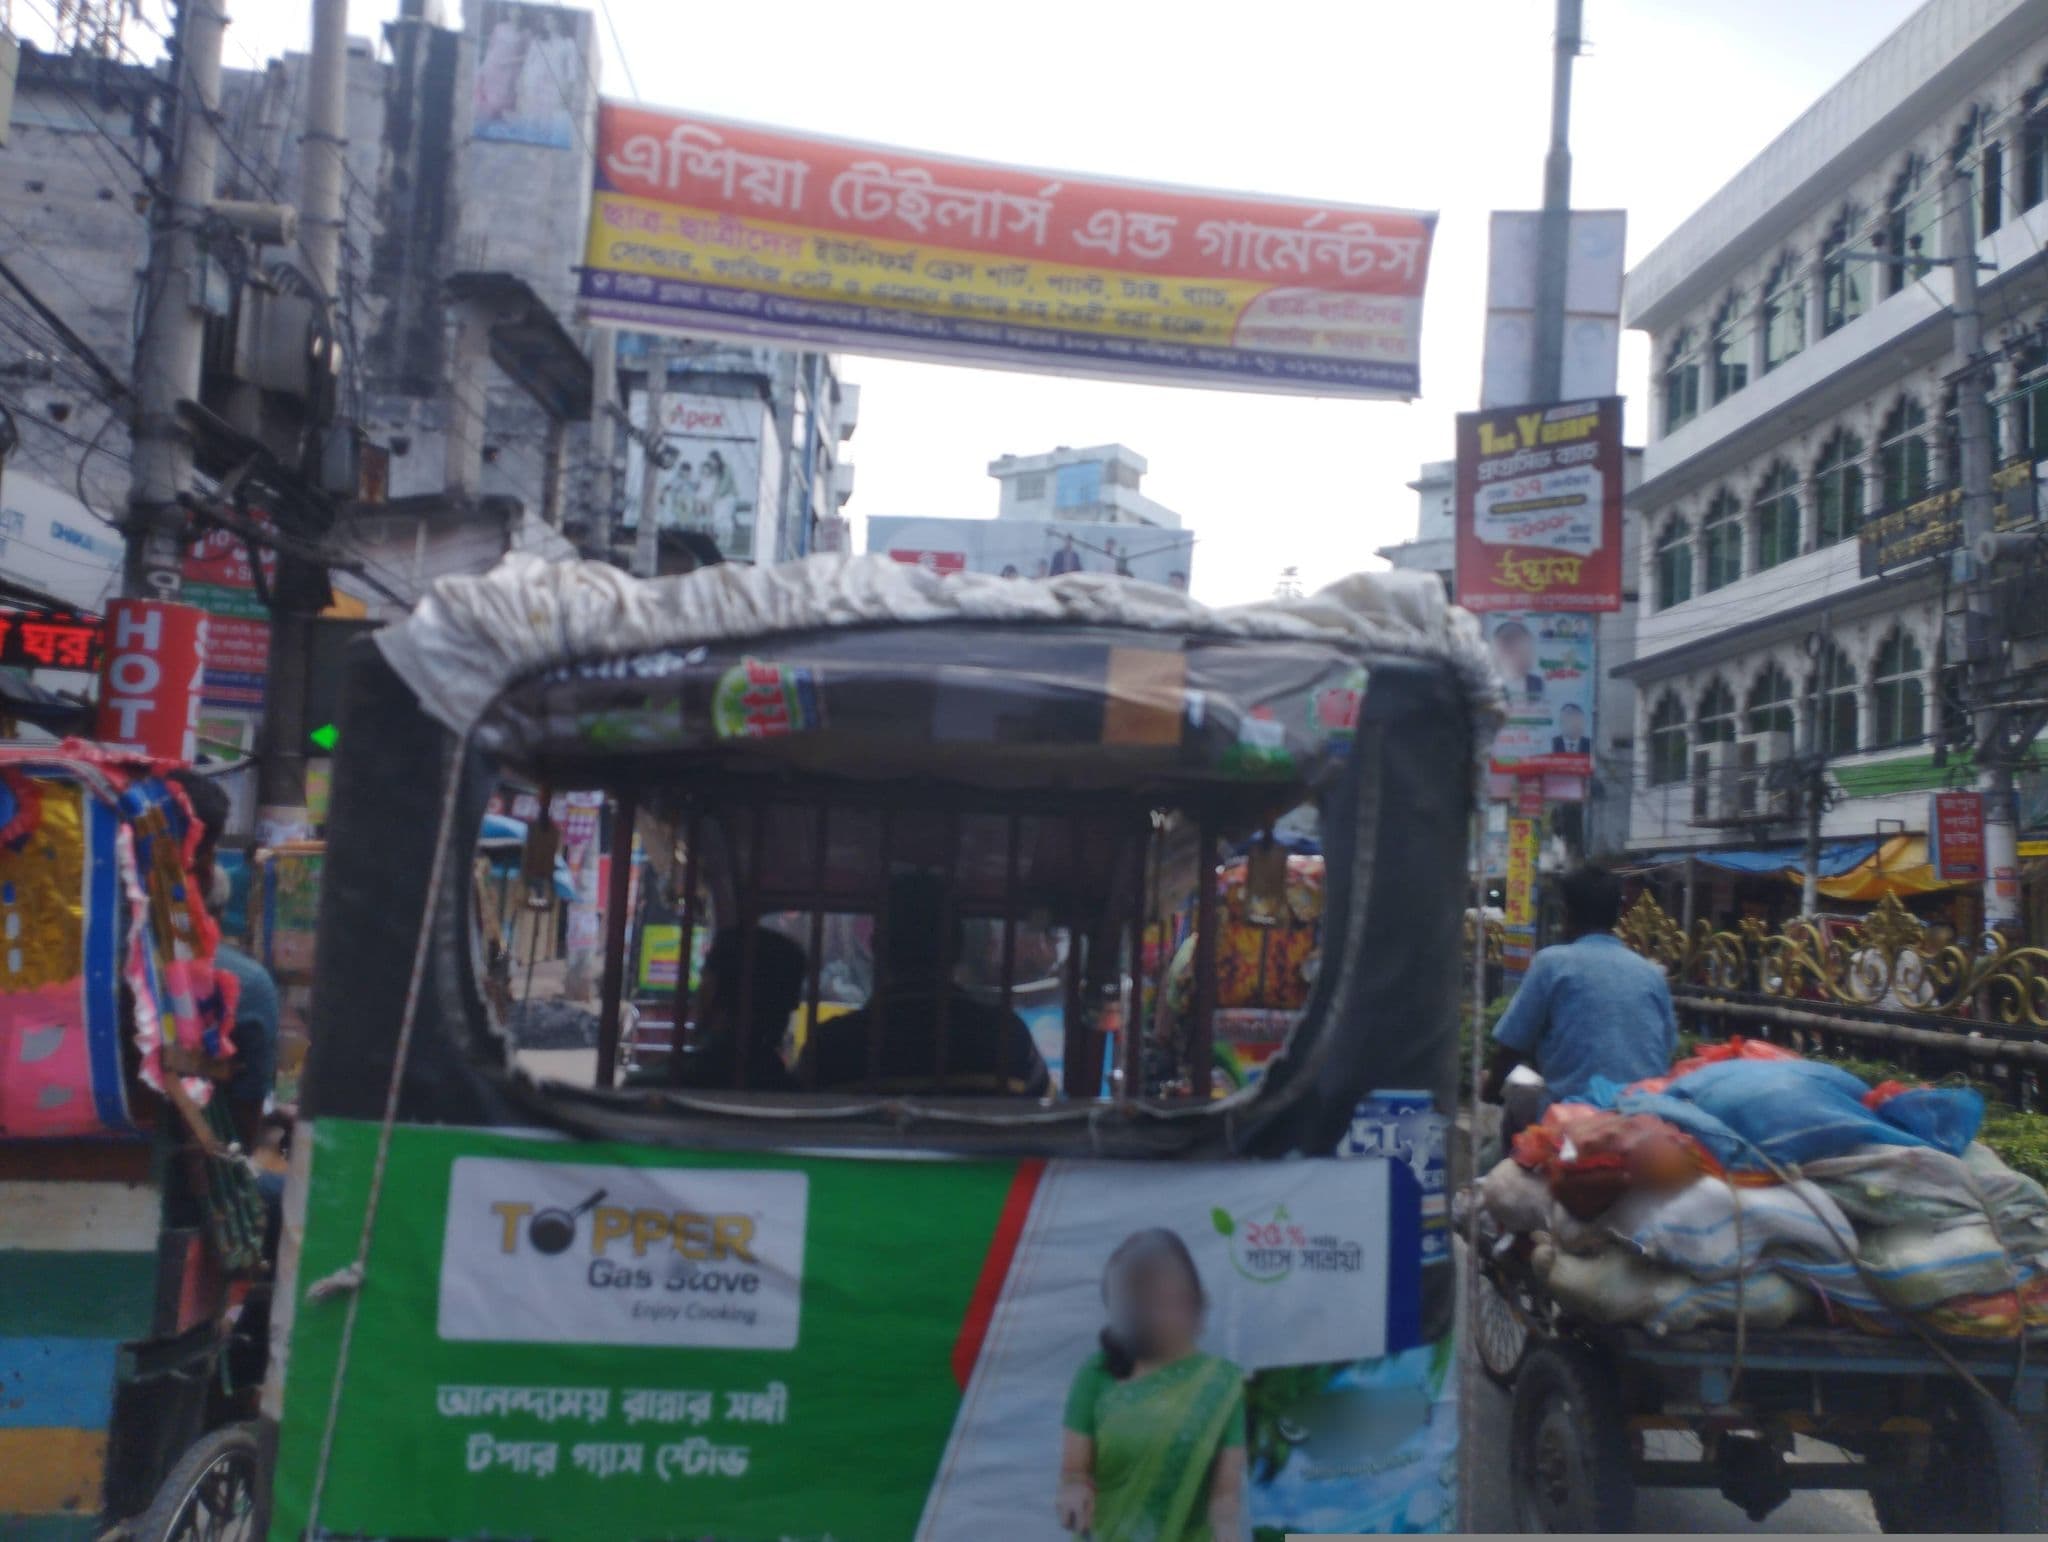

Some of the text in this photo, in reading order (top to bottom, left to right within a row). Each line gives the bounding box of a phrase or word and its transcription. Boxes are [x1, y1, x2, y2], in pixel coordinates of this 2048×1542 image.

[607, 122, 1423, 281] এশিয়া টেইলার্স এন্ড গার্মেন্টস
[668, 404, 725, 429] Apex
[104, 606, 163, 757] HOT
[587, 1258, 653, 1290] Gas
[631, 1300, 758, 1326] Enjoy Cooking
[465, 1431, 560, 1480] টপার
[571, 1441, 646, 1480] গ্যাস
